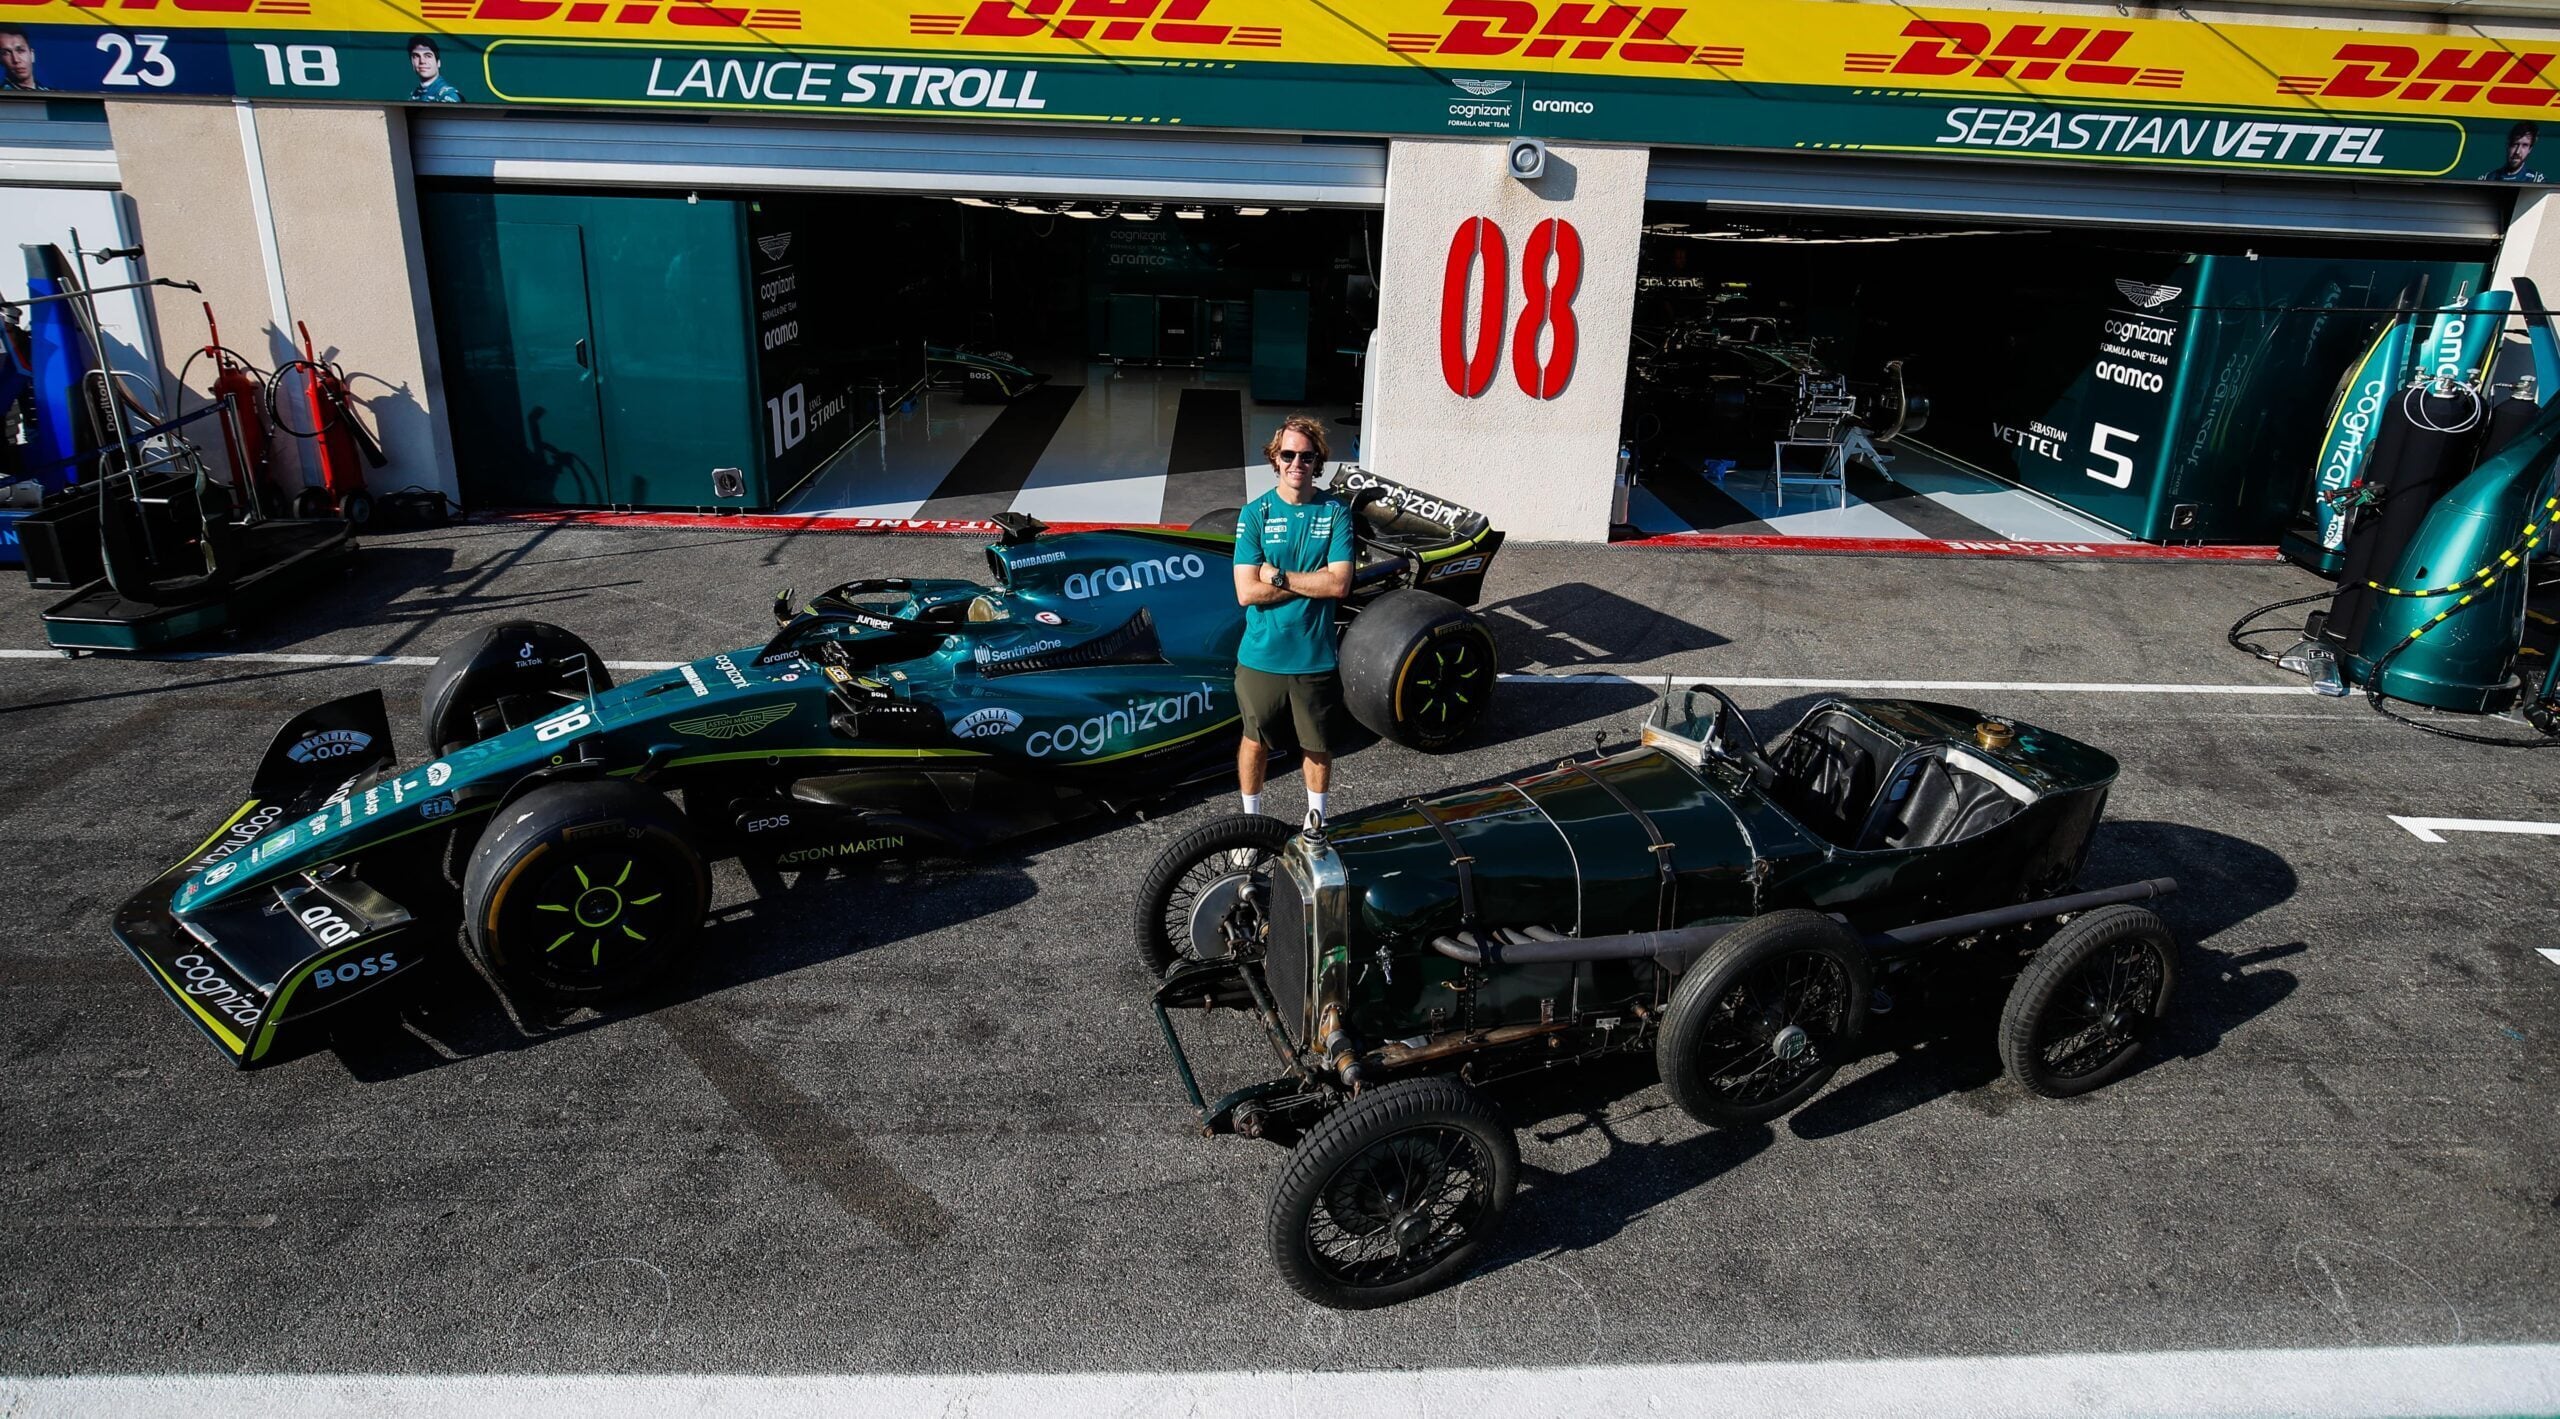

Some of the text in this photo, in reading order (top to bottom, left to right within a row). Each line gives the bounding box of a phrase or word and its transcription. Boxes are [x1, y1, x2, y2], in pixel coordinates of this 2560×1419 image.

[961, 0, 1234, 44] DHL
[1435, 0, 1699, 64] DHL
[96, 33, 176, 87] 23
[254, 44, 340, 87] 18
[1890, 20, 2141, 85] DHL
[646, 58, 1046, 109] LANCE STROLL
[2319, 44, 2551, 107] DHL
[1449, 104, 1512, 118] cognizant
[1532, 100, 1594, 114] aramco
[1448, 119, 1476, 127] FORMULA
[1493, 121, 1510, 129] TEAM
[1937, 107, 2384, 165] SEBASTIAN VETTEL
[1110, 254, 1166, 265] aramco
[761, 272, 796, 303] cognizant
[1440, 215, 1583, 399] 08
[764, 320, 798, 350] aramco
[2105, 321, 2176, 346] cognizant
[2435, 299, 2468, 391] ramc
[2100, 343, 2130, 358] FORMULA
[2149, 354, 2168, 365] TEAM
[969, 372, 992, 380] BOSS
[2095, 361, 2163, 393] aramco
[766, 383, 846, 459] 18 STROLL
[2029, 420, 2068, 442] SEBASTIAN
[1992, 422, 2140, 489] VETTEL 5
[1010, 551, 1067, 571] BOMBARDIER
[1064, 553, 1205, 600] aramco
[1430, 557, 1483, 579] JCB
[515, 658, 543, 668] TikTok
[763, 649, 800, 664] aramco
[991, 638, 1062, 662] SentinelOne
[715, 654, 751, 690] cognizant
[533, 704, 592, 742] 18
[707, 712, 763, 729] ASTON MARTIN
[964, 709, 1009, 727] ITALIA
[1026, 681, 1214, 758] cognizant
[300, 732, 353, 750] ITALIA
[776, 835, 904, 865] ASTON MARTIN
[301, 906, 361, 948] ara
[314, 952, 398, 990] BOSS
[175, 954, 263, 1028] cogniza
